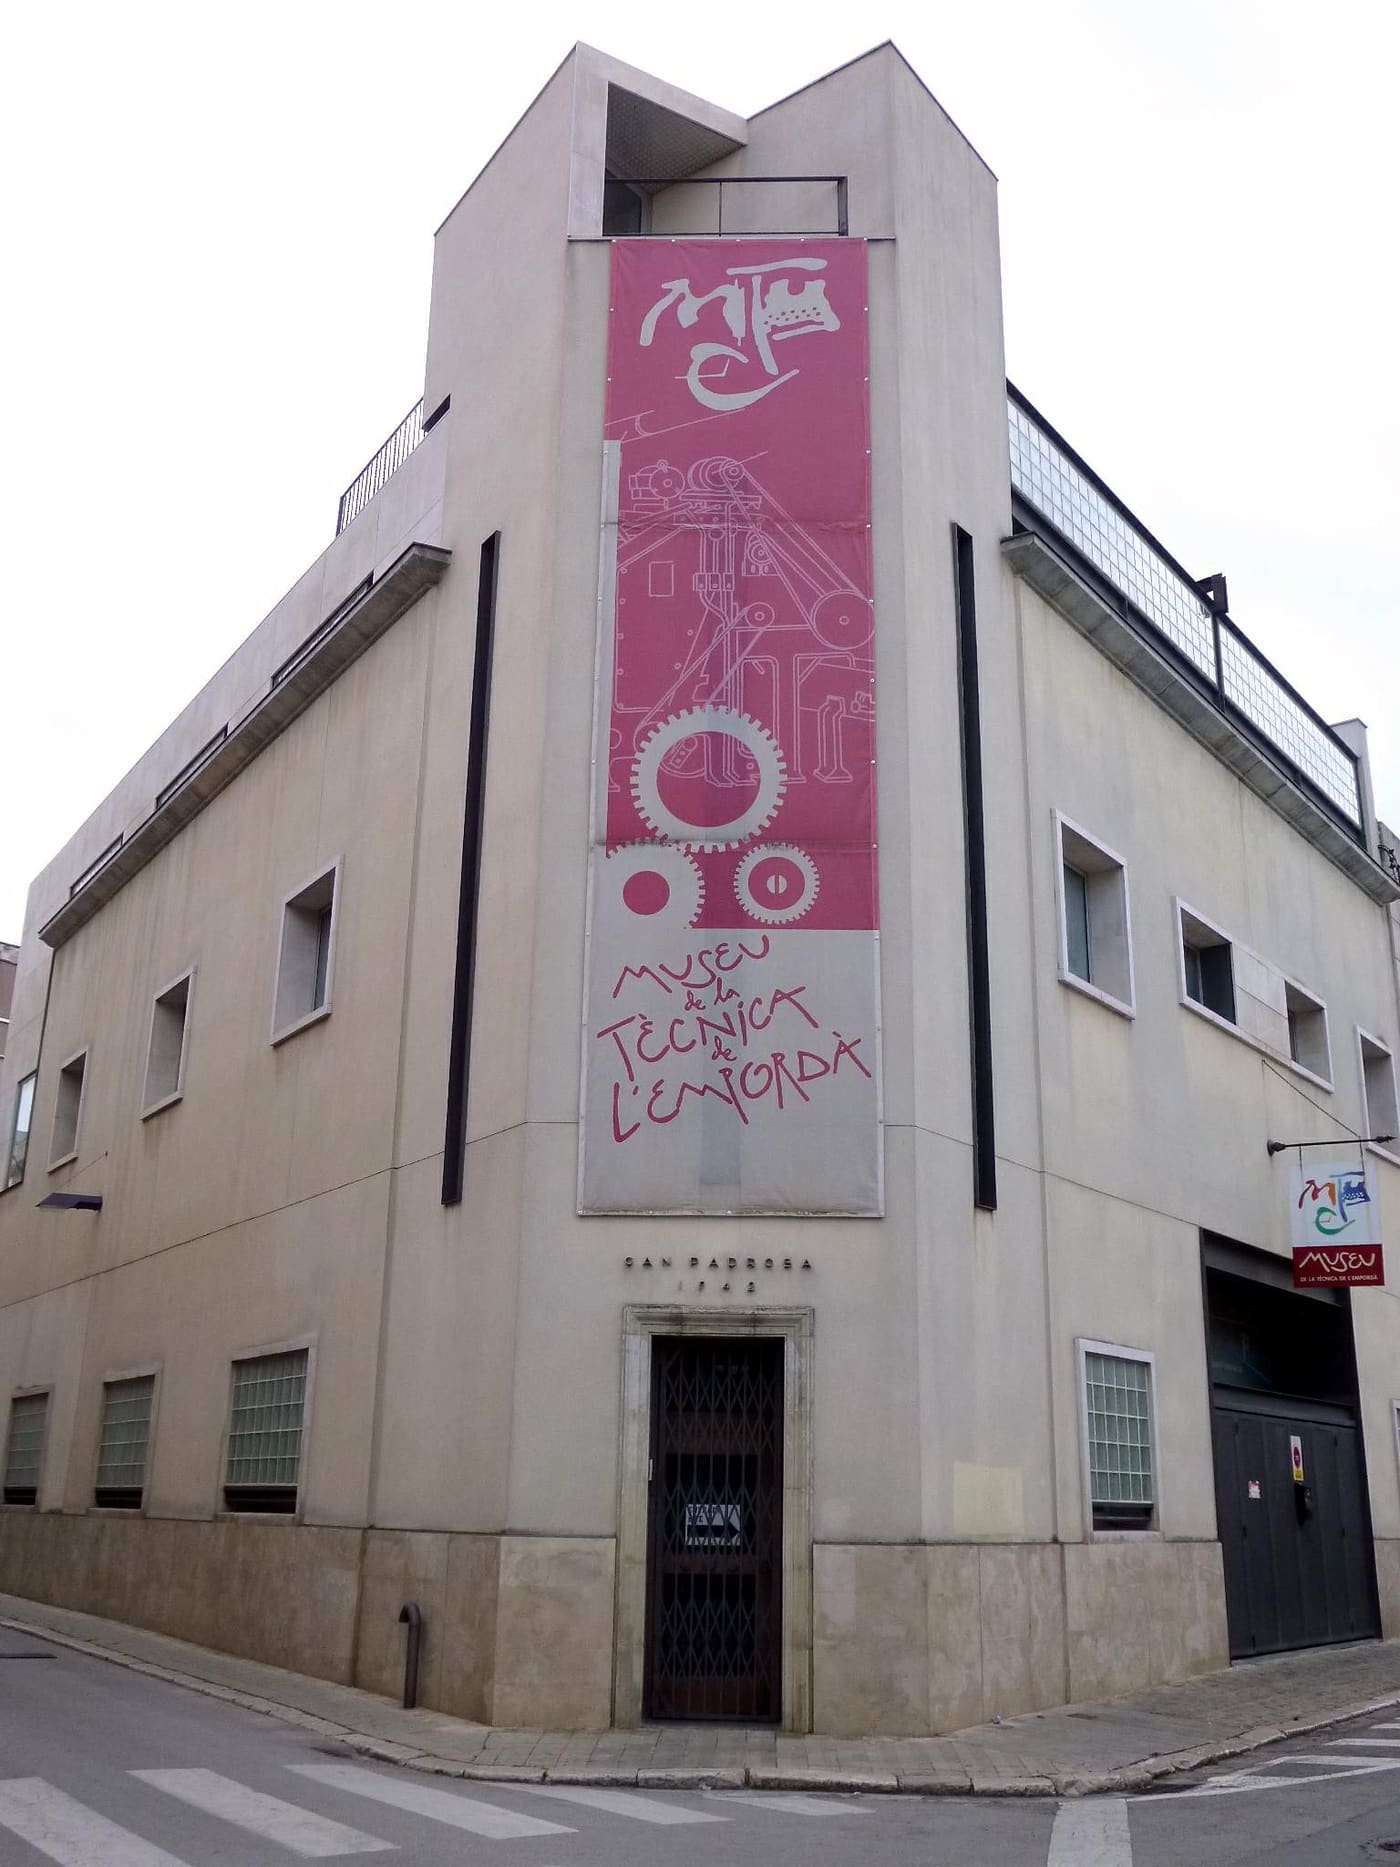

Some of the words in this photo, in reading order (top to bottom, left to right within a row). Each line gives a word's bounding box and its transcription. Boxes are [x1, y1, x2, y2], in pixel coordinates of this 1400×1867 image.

[613, 934, 770, 998] MUSEU
[684, 990, 706, 1011] de
[714, 977, 740, 1005] la
[712, 1035, 738, 1062] de
[613, 1031, 872, 1143] L'EMPORDÀ
[690, 1256, 812, 1269] PADROSA
[1299, 1251, 1376, 1272] MUSEU
